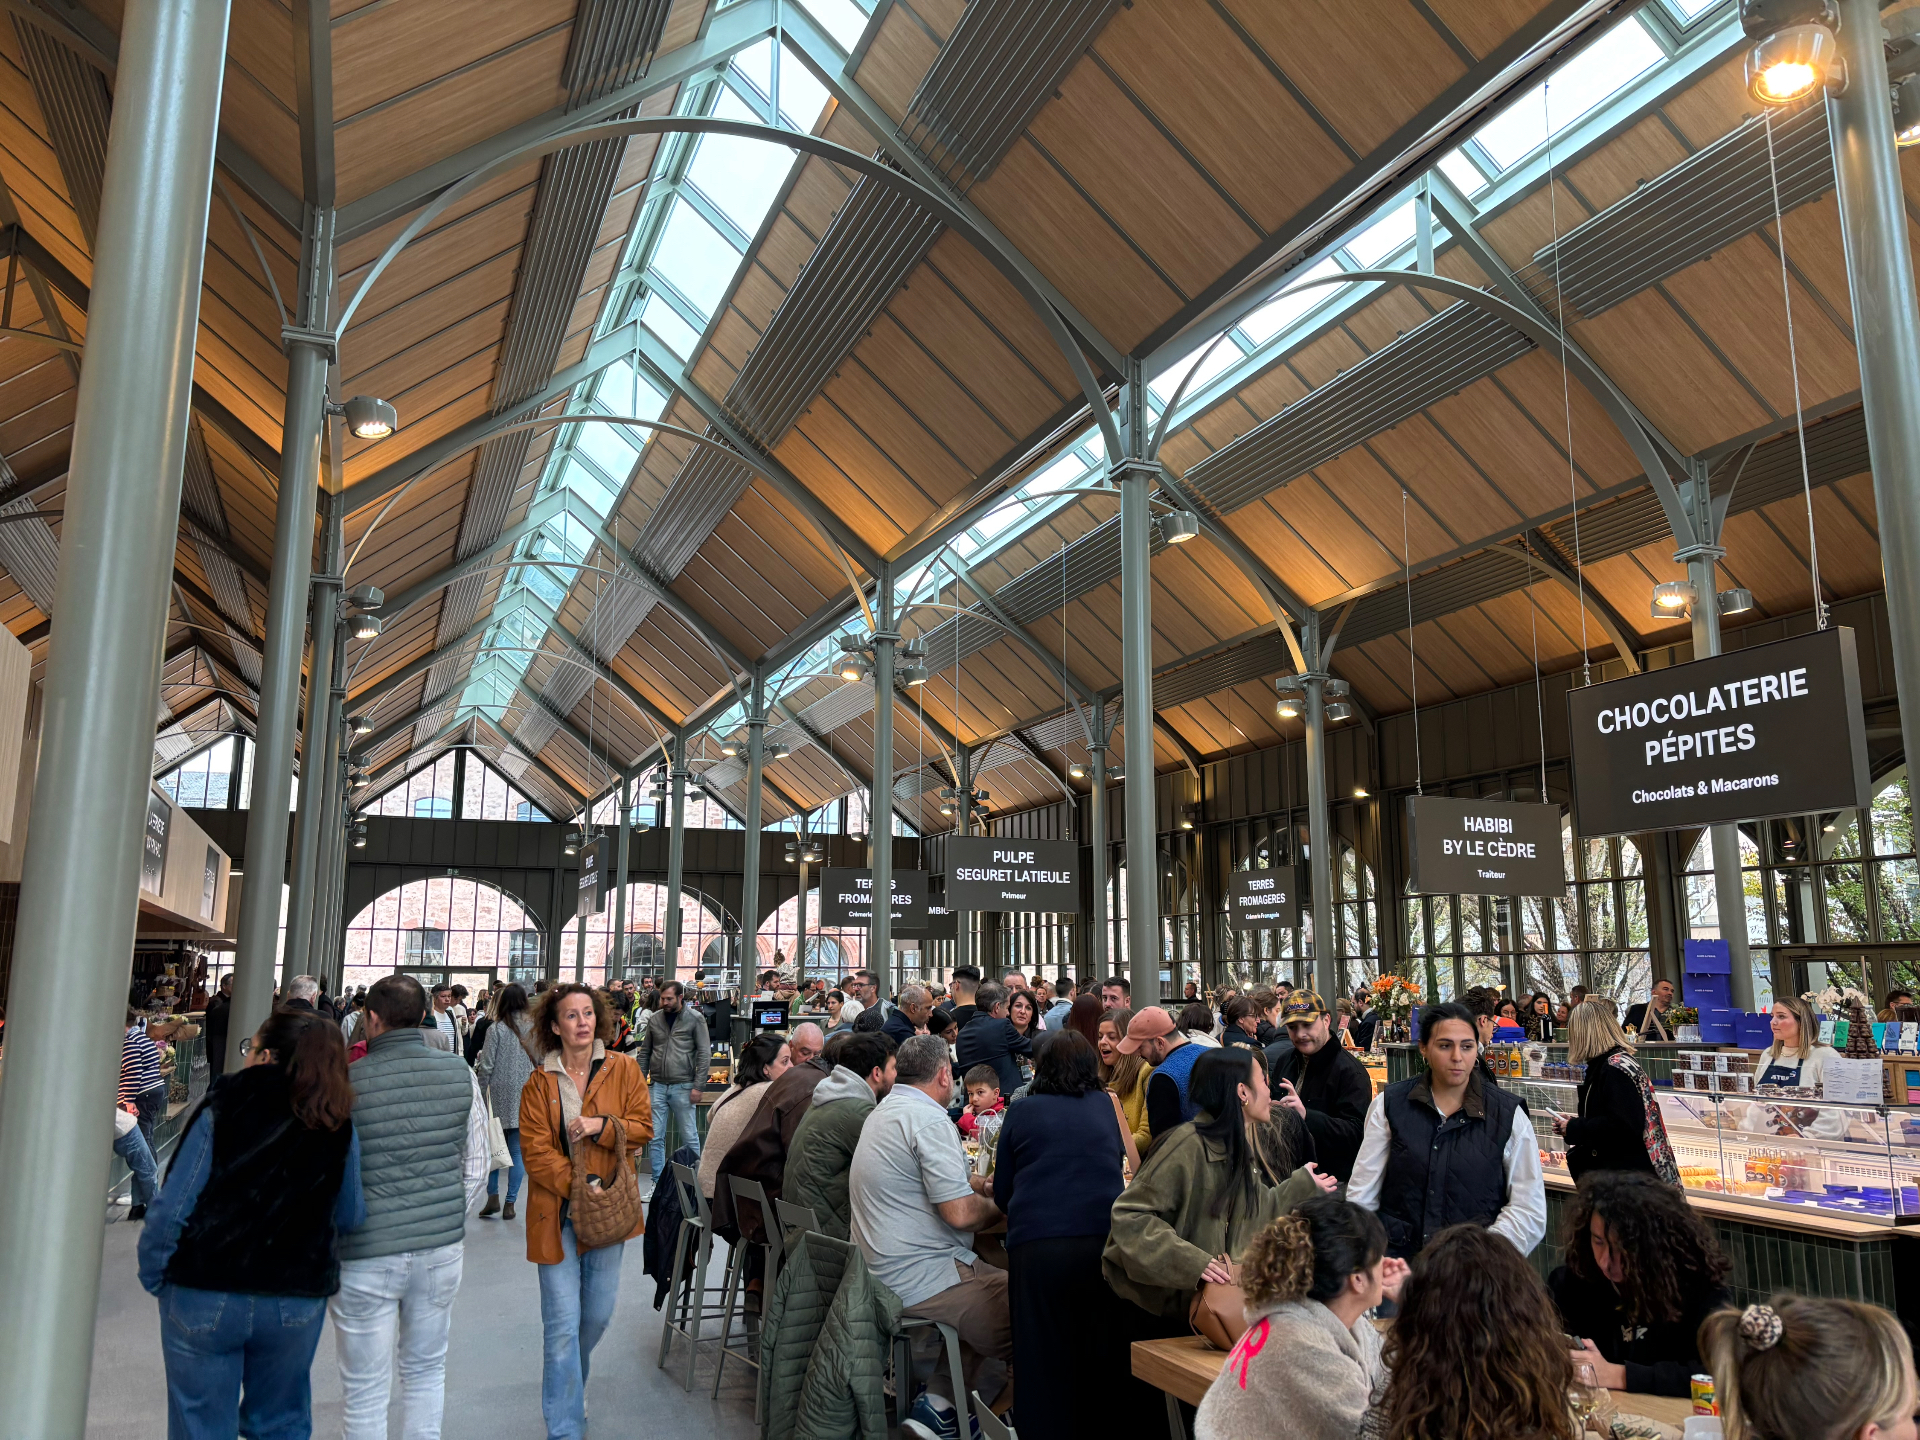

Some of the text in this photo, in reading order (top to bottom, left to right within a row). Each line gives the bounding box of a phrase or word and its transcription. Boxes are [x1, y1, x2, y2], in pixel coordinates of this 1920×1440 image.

[1597, 667, 1809, 734] CHOCOLATERIE
[1645, 723, 1756, 766] PÉPITES
[1632, 773, 1779, 804] Chocolats & Macarons
[1464, 816, 1513, 834] HABIBI
[1443, 837, 1536, 859] BY LE CÈDRE
[993, 850, 1035, 864] PULPE
[956, 867, 1071, 884] SEGURET LATIEULE
[1248, 878, 1275, 890] TERRES
[1001, 891, 1026, 900] Primeur
[1239, 892, 1286, 907] FROMAGERES
